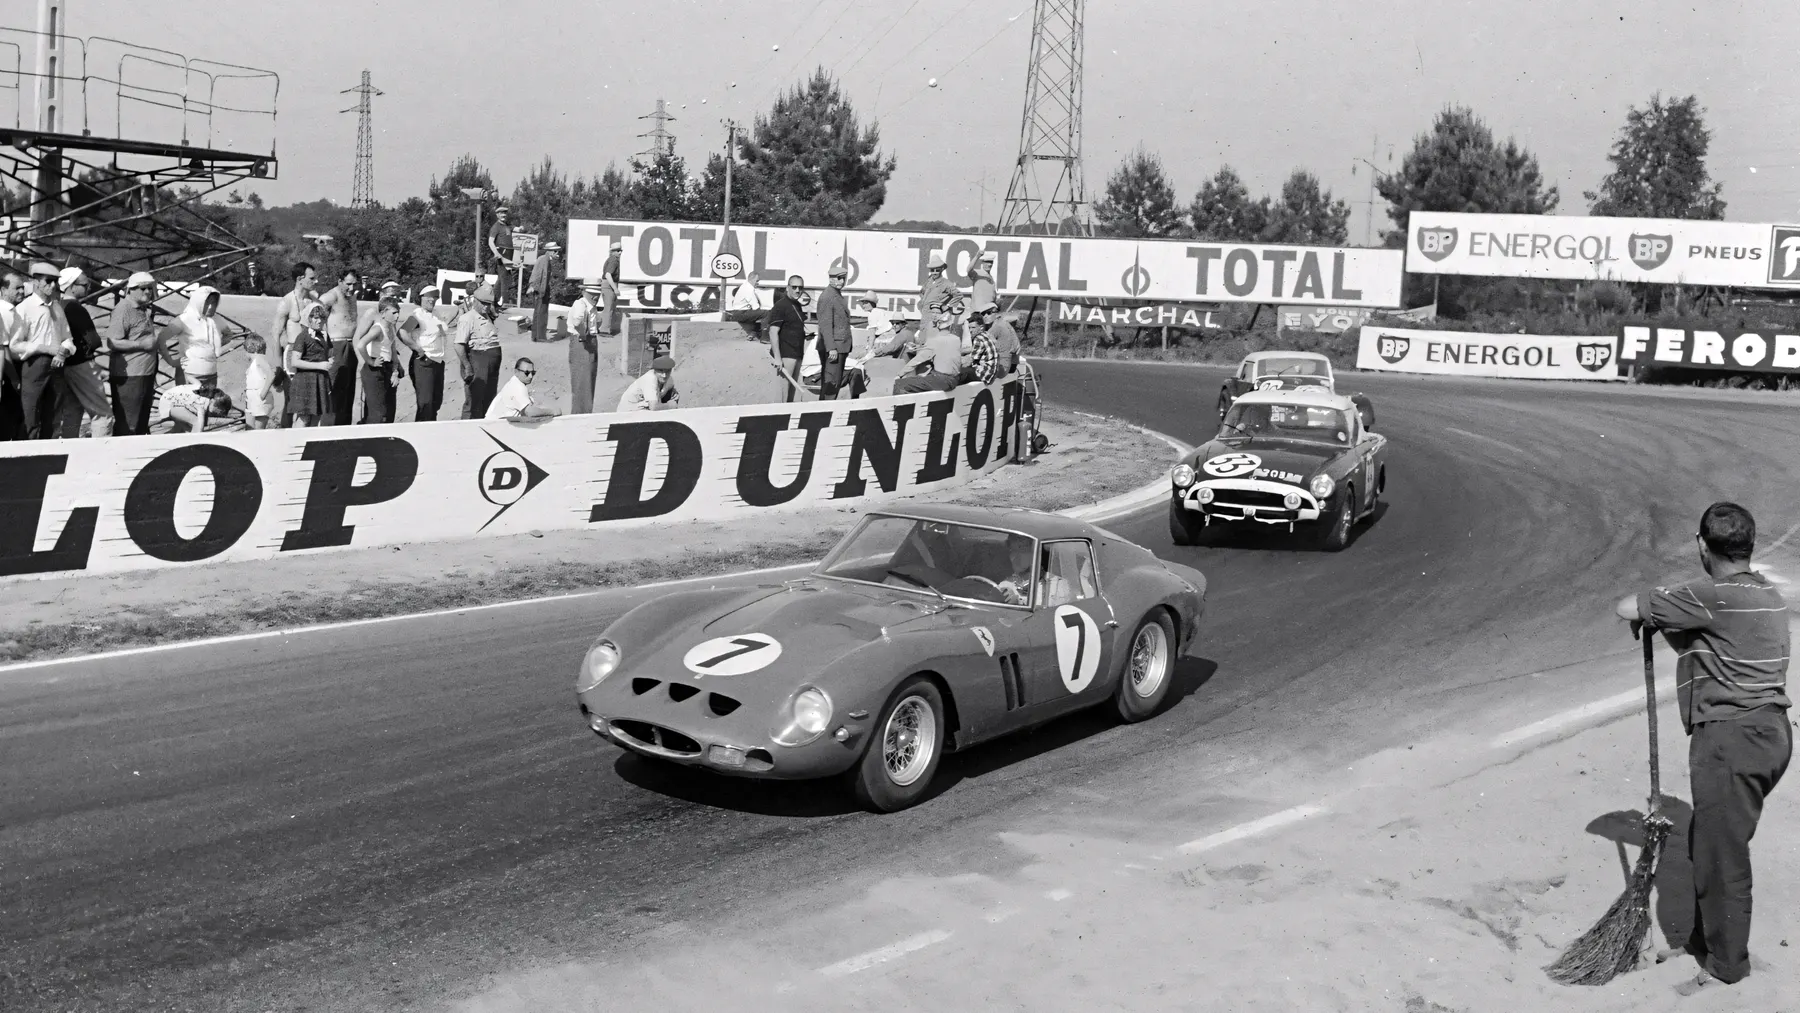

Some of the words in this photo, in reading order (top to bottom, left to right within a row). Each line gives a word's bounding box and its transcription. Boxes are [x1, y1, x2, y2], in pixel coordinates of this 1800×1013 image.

[597, 223, 786, 281] TOTAL
[908, 237, 1087, 291] TOTAL
[1186, 246, 1362, 300] TOTAL
[1423, 231, 1454, 253] BP
[1469, 232, 1619, 261] ENERGOL
[1634, 238, 1668, 261] BP
[1689, 244, 1763, 261] PNEUS
[715, 259, 739, 270] Esso
[1058, 301, 1220, 329] MARCHAL
[1381, 338, 1409, 358] BP
[1426, 342, 1561, 367] ENERGOL
[1579, 346, 1611, 366] BP
[1621, 325, 1800, 369] FEROD
[588, 381, 1028, 523] DUNLOP
[0, 437, 419, 576] LOP
[488, 467, 522, 491] D
[695, 638, 771, 669] 7
[1061, 612, 1086, 681] 7
